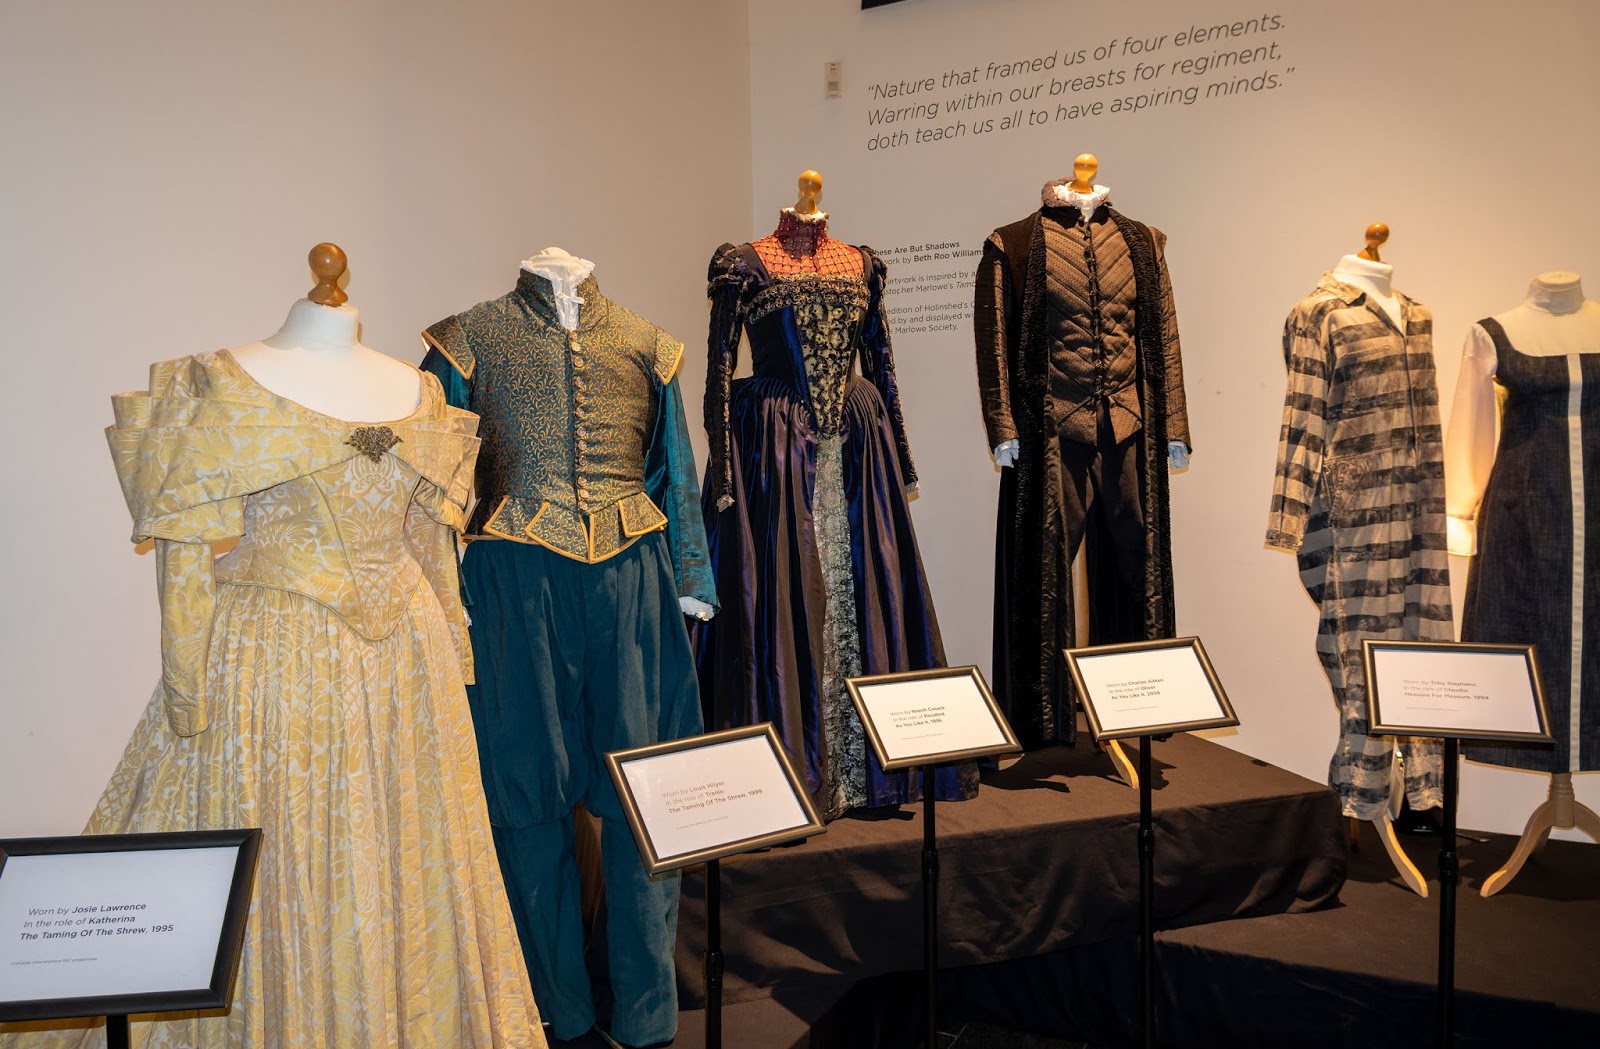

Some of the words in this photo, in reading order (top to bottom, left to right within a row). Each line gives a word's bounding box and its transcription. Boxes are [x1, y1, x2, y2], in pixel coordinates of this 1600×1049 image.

[868, 78, 935, 100] “Nature
[942, 66, 980, 89] that
[985, 50, 1058, 81] framed
[1063, 50, 1086, 66] us
[1093, 39, 1118, 60] of
[1122, 34, 1168, 56] four
[1174, 13, 1285, 47] elements.
[868, 102, 939, 126] Warring
[946, 89, 1002, 113] within
[1009, 83, 1044, 102] our
[1049, 69, 1125, 97] breasts
[1134, 62, 1165, 82] for
[1171, 41, 1281, 75] regiment,
[867, 129, 909, 151] doth
[915, 120, 966, 144] teach
[973, 119, 994, 135] us
[1000, 109, 1023, 130] all
[1028, 109, 1049, 126] to
[1055, 101, 1104, 121] have
[1110, 85, 1199, 113] aspiring
[874, 249, 892, 257] hese
[894, 247, 907, 255] Are
[910, 245, 923, 253] But
[925, 241, 960, 251] Shadows
[902, 256, 911, 265] by
[914, 254, 931, 262] Beth
[934, 252, 950, 260] Roo
[926, 271, 957, 281] inspired
[959, 270, 968, 279] by
[915, 304, 923, 312] of
[898, 316, 907, 325] by
[909, 315, 923, 323] and
[926, 312, 962, 324] displayed
[895, 325, 926, 333] Marlowe
[929, 323, 958, 332] Society.
[682, 801, 704, 810] Taming
[29, 908, 54, 916] Worn
[57, 907, 69, 916] by
[72, 905, 97, 914] Josie
[100, 903, 146, 912] Lawrence
[24, 920, 33, 928] In
[36, 919, 51, 927] the
[54, 918, 73, 927] role
[76, 917, 87, 926] of
[88, 915, 136, 925] Katherina
[20, 932, 38, 941] The
[42, 930, 77, 939] Taming
[80, 929, 93, 937] Of
[96, 928, 113, 936] The
[151, 924, 174, 933] 1995
